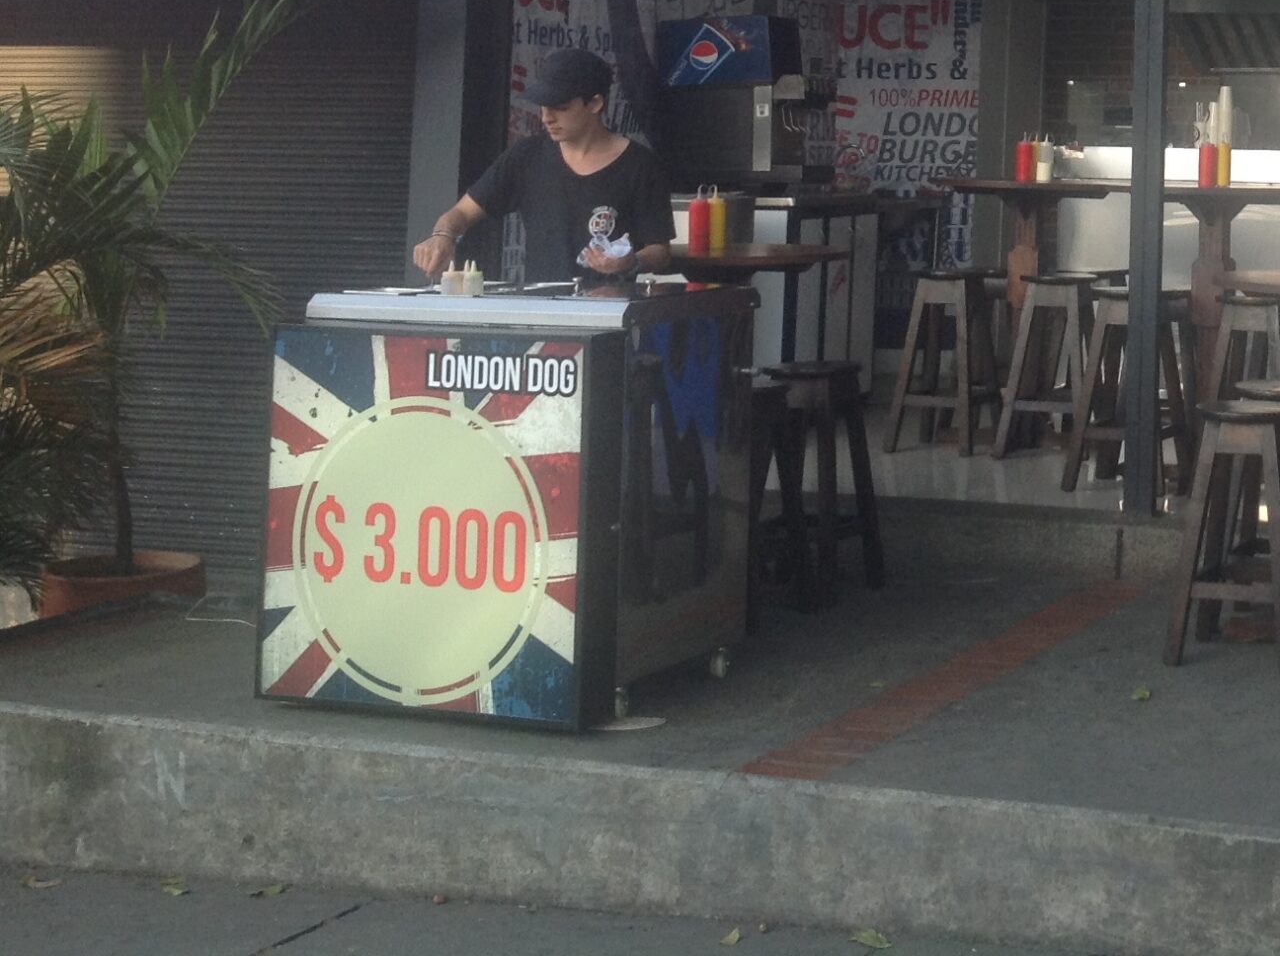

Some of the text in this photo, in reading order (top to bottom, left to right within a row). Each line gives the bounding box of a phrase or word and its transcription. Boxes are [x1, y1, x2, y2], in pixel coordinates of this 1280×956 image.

[528, 18, 574, 49] Herbs
[856, 58, 938, 80] Herbs
[950, 60, 969, 80] &
[883, 111, 979, 138] LONDO
[878, 138, 977, 164] BURGE
[427, 352, 577, 395] LONDON DOG
[363, 501, 527, 594] 3.000
